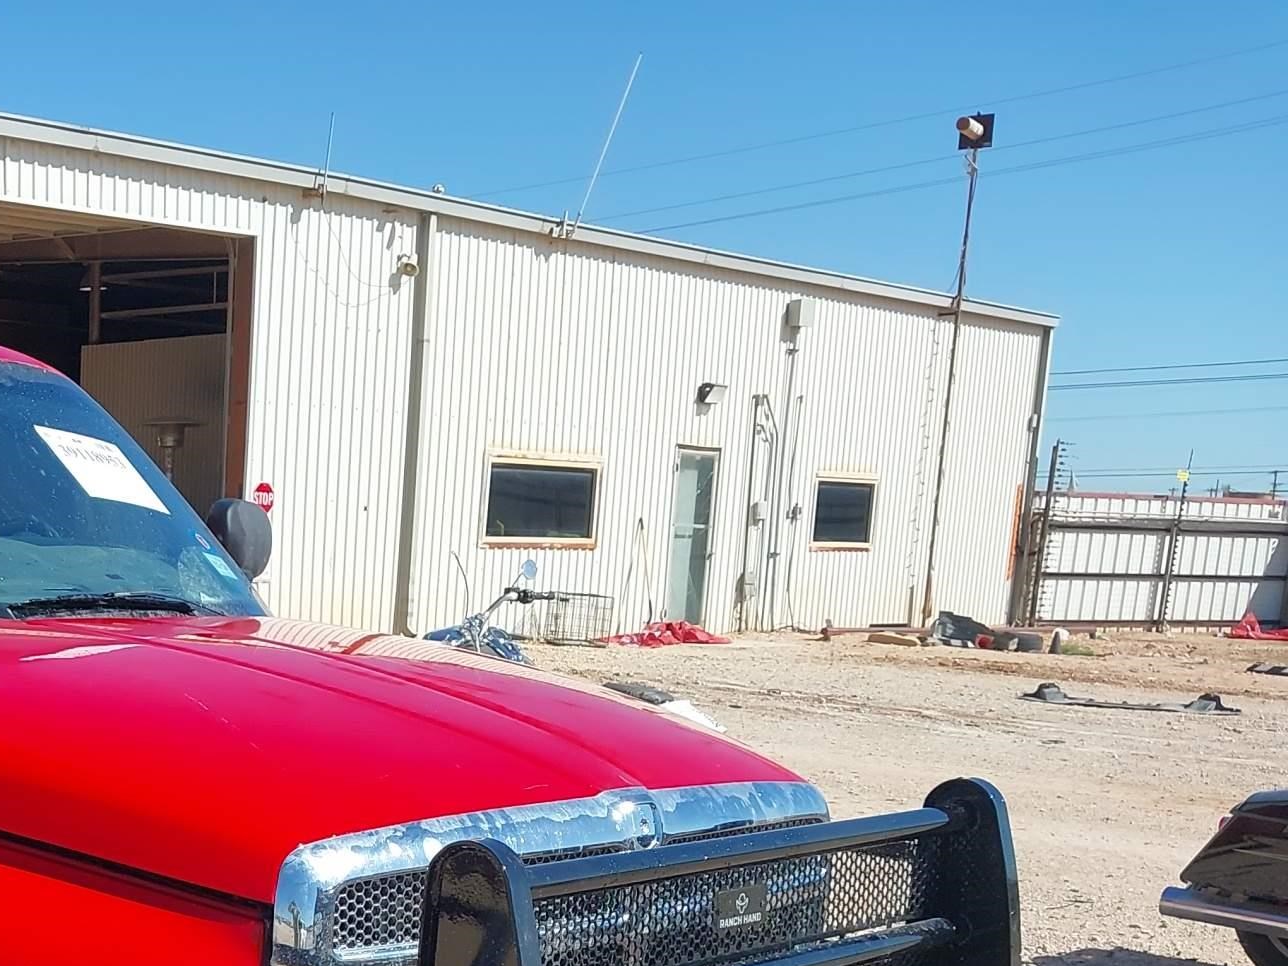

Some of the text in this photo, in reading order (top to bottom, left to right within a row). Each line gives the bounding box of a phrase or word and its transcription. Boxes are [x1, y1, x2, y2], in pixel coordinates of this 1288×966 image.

[254, 491, 274, 506] STOP
[719, 912, 762, 929] RANCH HAND
